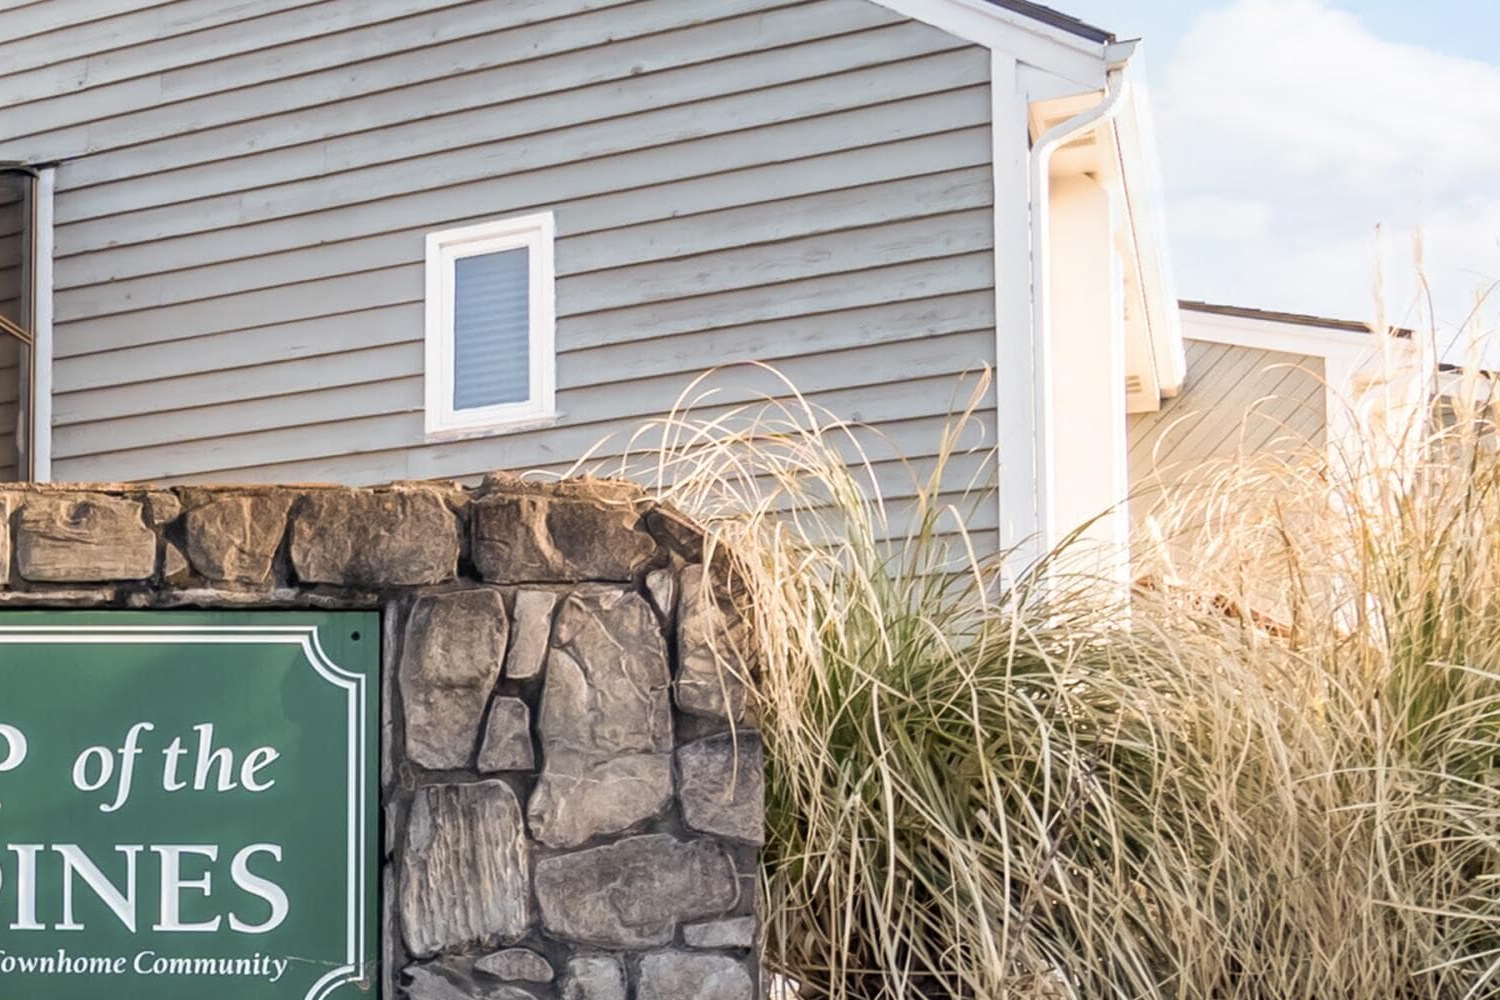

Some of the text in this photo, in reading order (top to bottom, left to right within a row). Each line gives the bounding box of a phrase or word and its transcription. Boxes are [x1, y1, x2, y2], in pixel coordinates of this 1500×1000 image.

[72, 721, 155, 813] of
[162, 721, 281, 793] the
[132, 949, 288, 983] Community
